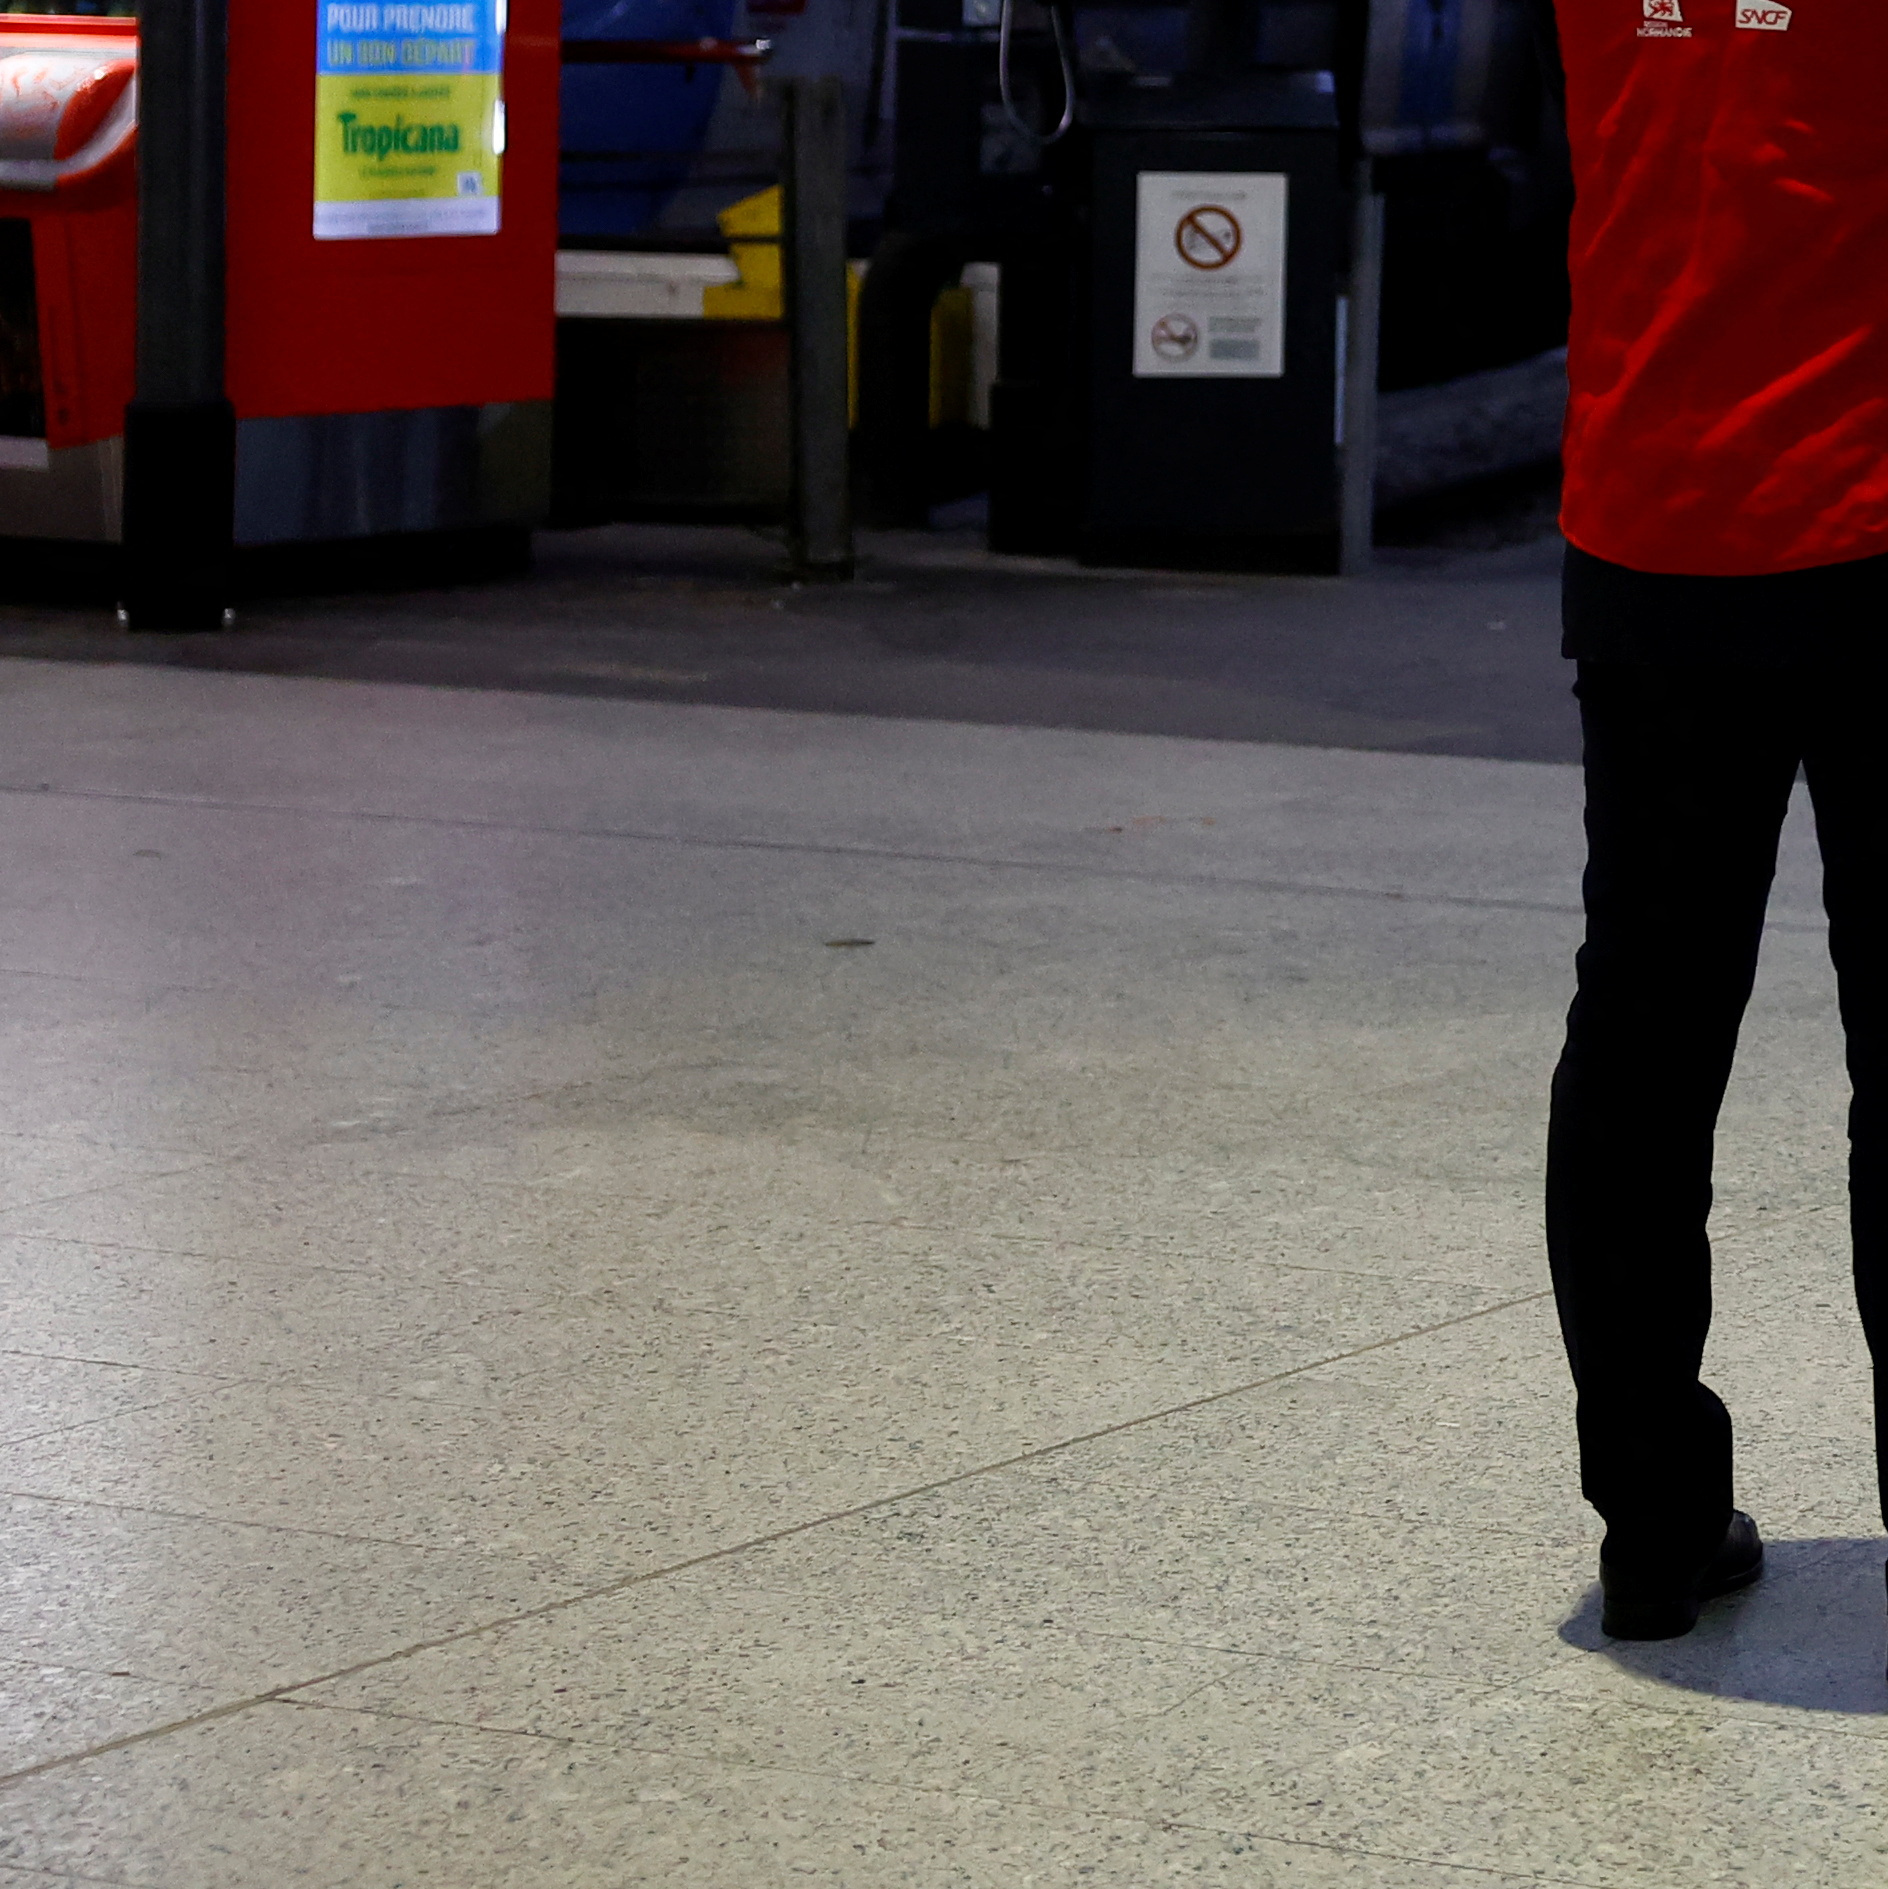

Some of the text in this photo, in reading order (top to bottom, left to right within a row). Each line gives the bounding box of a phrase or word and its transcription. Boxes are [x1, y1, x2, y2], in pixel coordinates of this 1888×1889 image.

[327, 4, 475, 33] POUR PRENDRE
[1739, 9, 1788, 24] SNCF
[328, 40, 354, 65] UN
[337, 111, 459, 161] Tropicana
